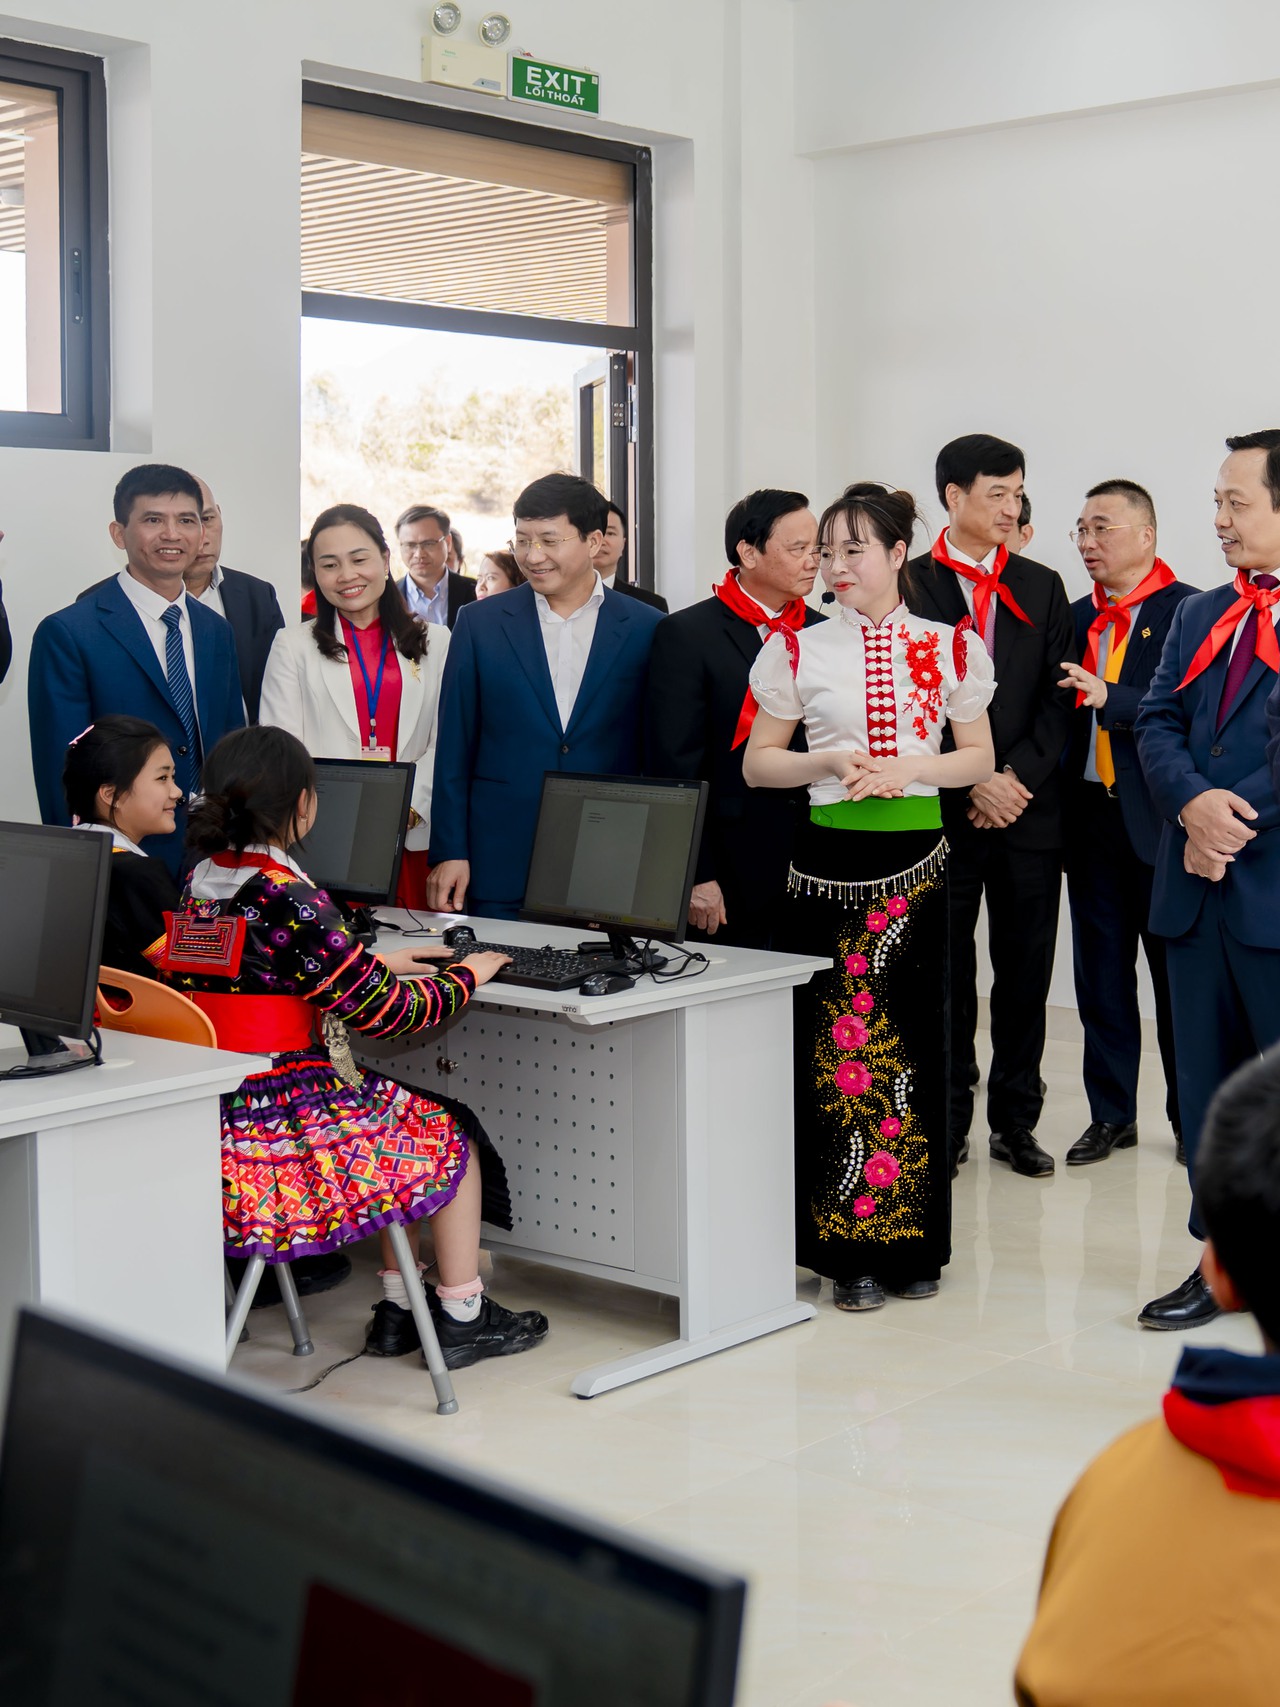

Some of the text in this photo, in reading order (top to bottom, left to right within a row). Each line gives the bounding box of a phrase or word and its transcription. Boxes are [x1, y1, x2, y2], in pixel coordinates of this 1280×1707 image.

[526, 65, 586, 95] EXIT
[525, 84, 586, 106] LỐI THOÁT
